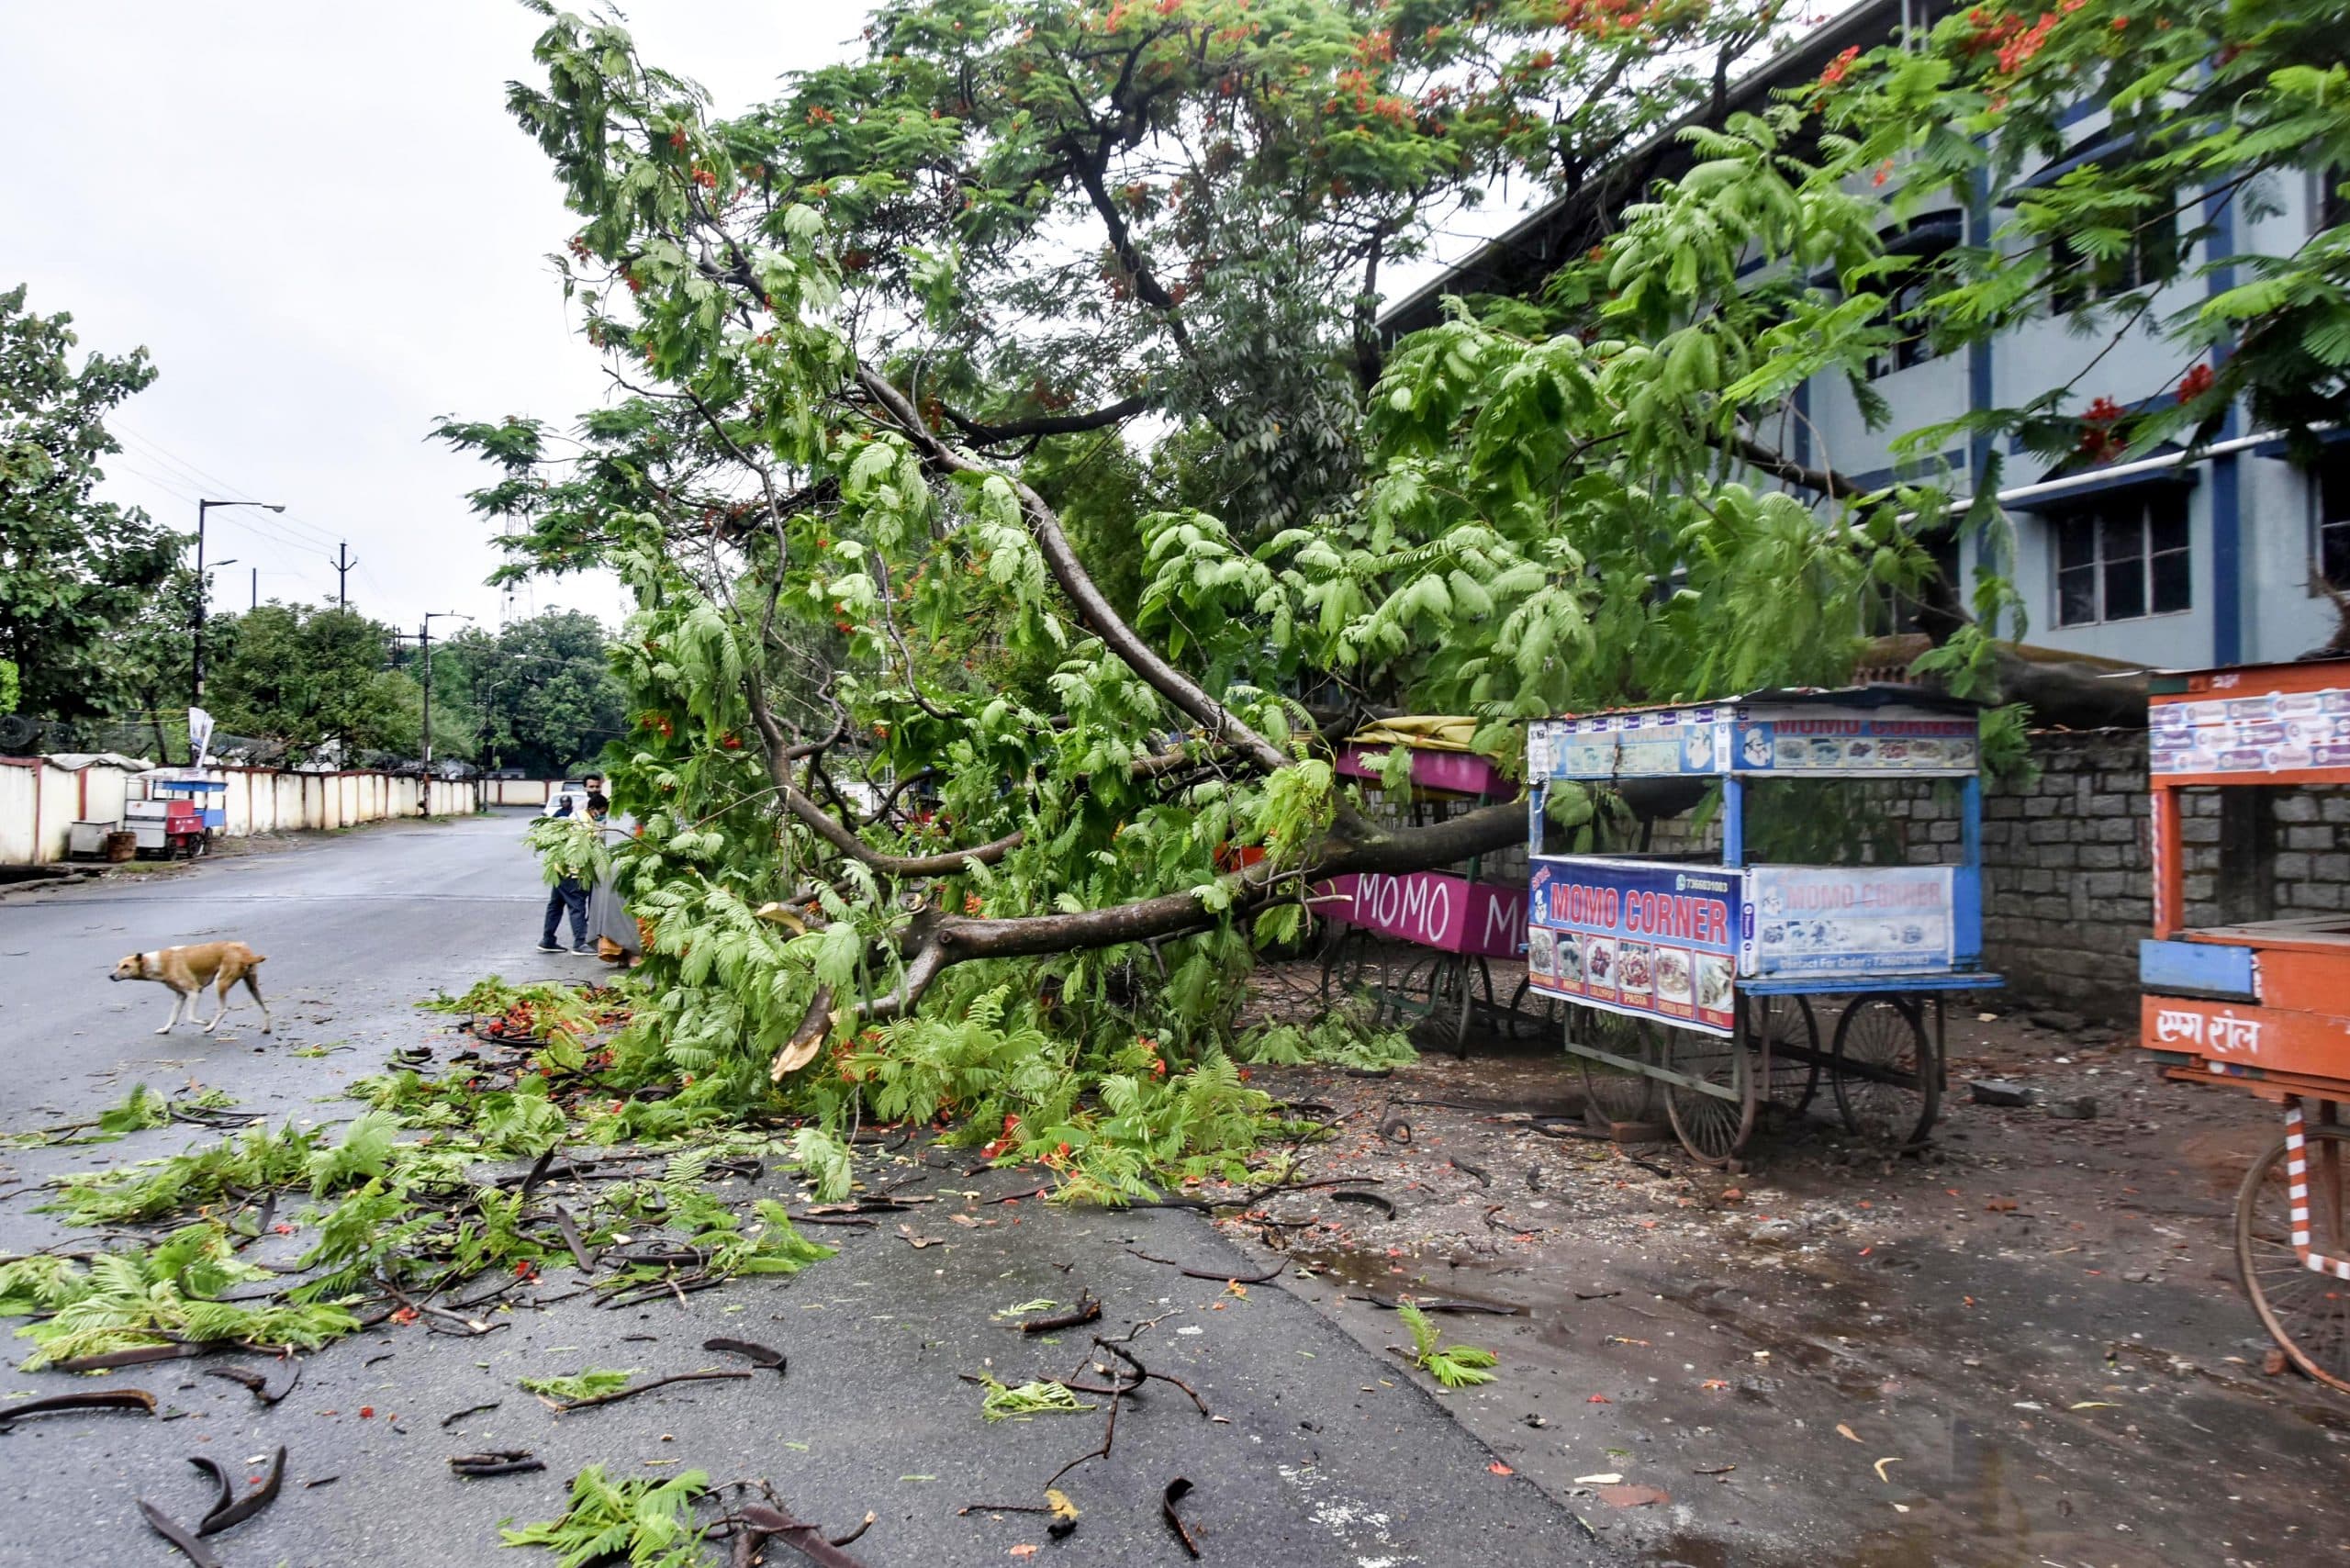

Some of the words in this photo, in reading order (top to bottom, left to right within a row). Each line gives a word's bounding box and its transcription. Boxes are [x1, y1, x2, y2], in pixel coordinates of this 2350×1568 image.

[1354, 873, 1450, 942] MOMO
[1483, 894, 1529, 955] M
[1550, 882, 1619, 930] MOMO
[1625, 889, 1729, 946] CORNER
[1786, 884, 1855, 911] MOMO
[1862, 881, 1943, 909] CORNER
[1624, 992, 1649, 1007] PASTA
